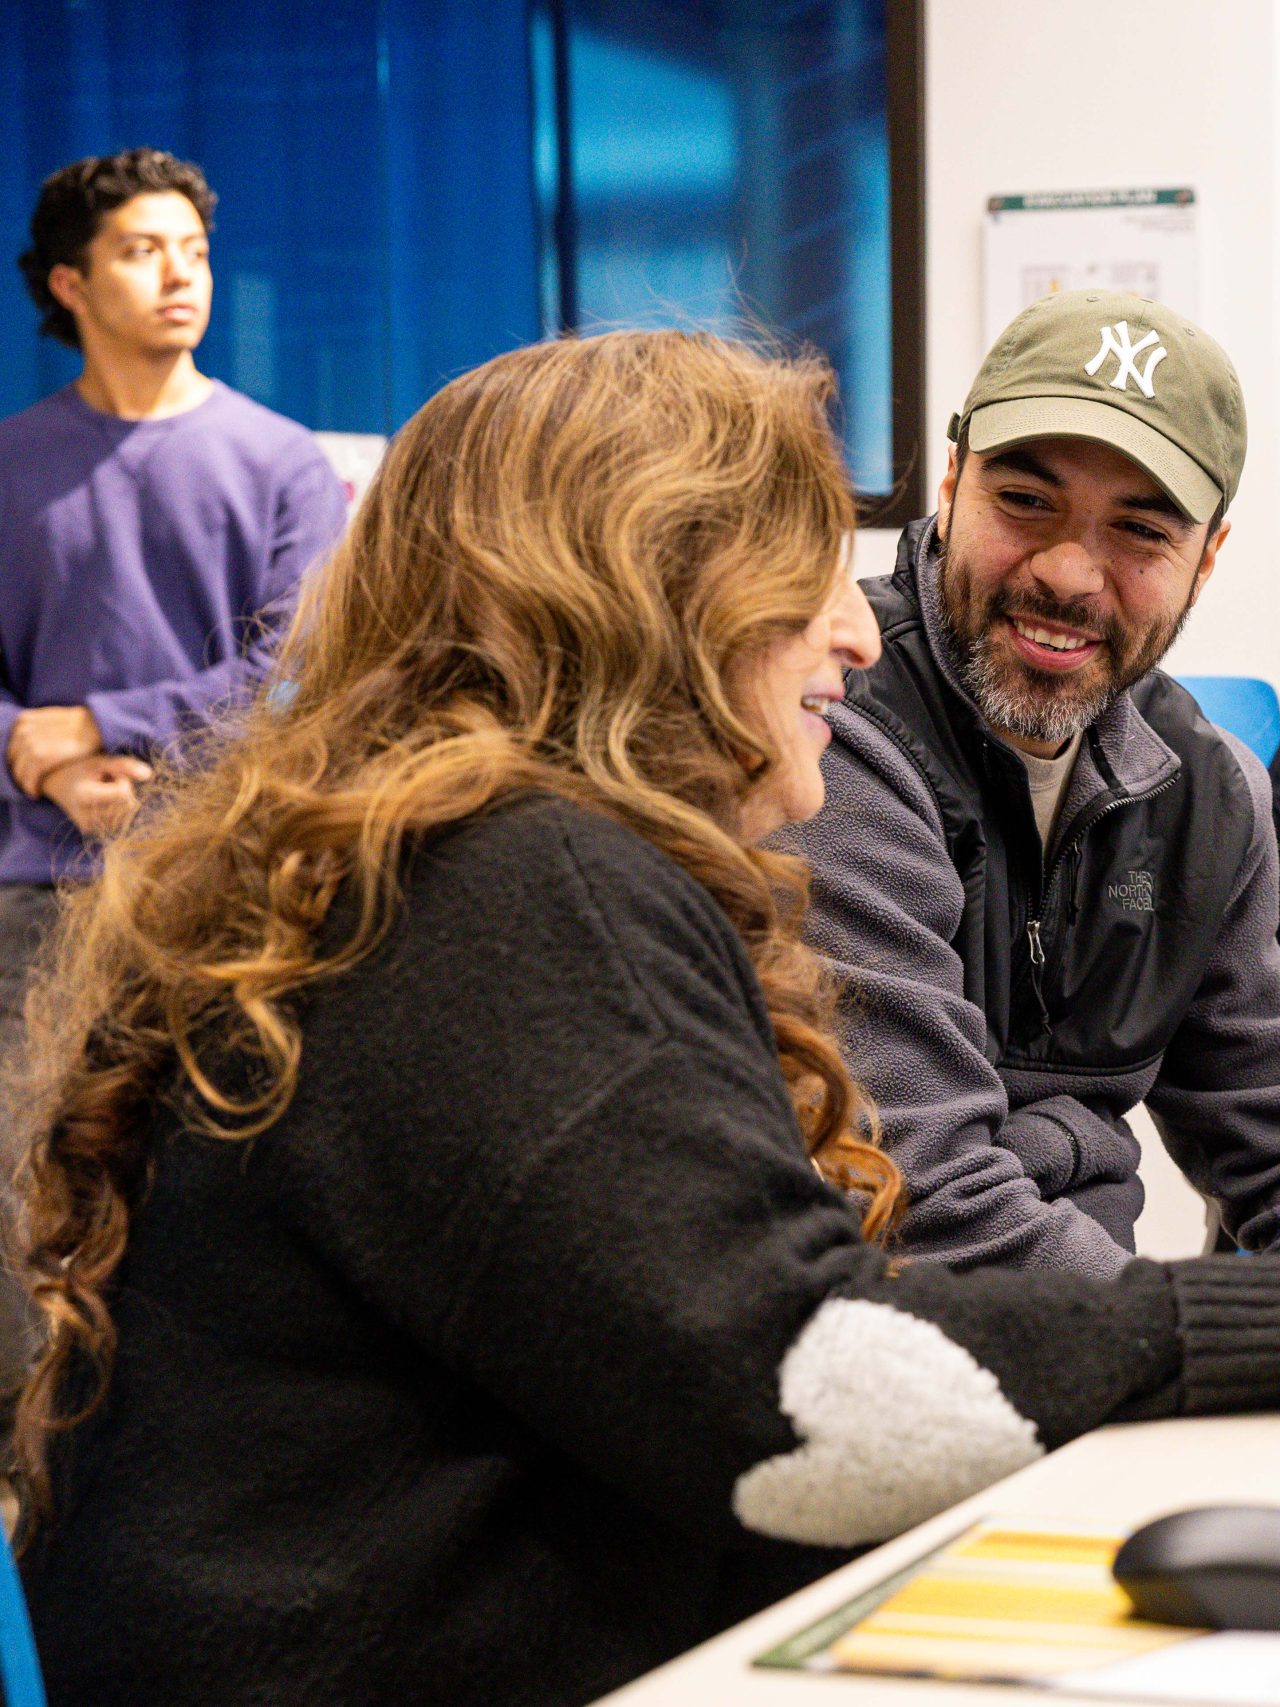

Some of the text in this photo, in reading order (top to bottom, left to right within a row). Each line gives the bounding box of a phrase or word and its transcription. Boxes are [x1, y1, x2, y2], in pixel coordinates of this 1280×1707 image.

[1083, 320, 1168, 399] NY
[1127, 870, 1148, 884] THE
[1108, 883, 1148, 899] NORTH
[1122, 896, 1150, 911] FACE
